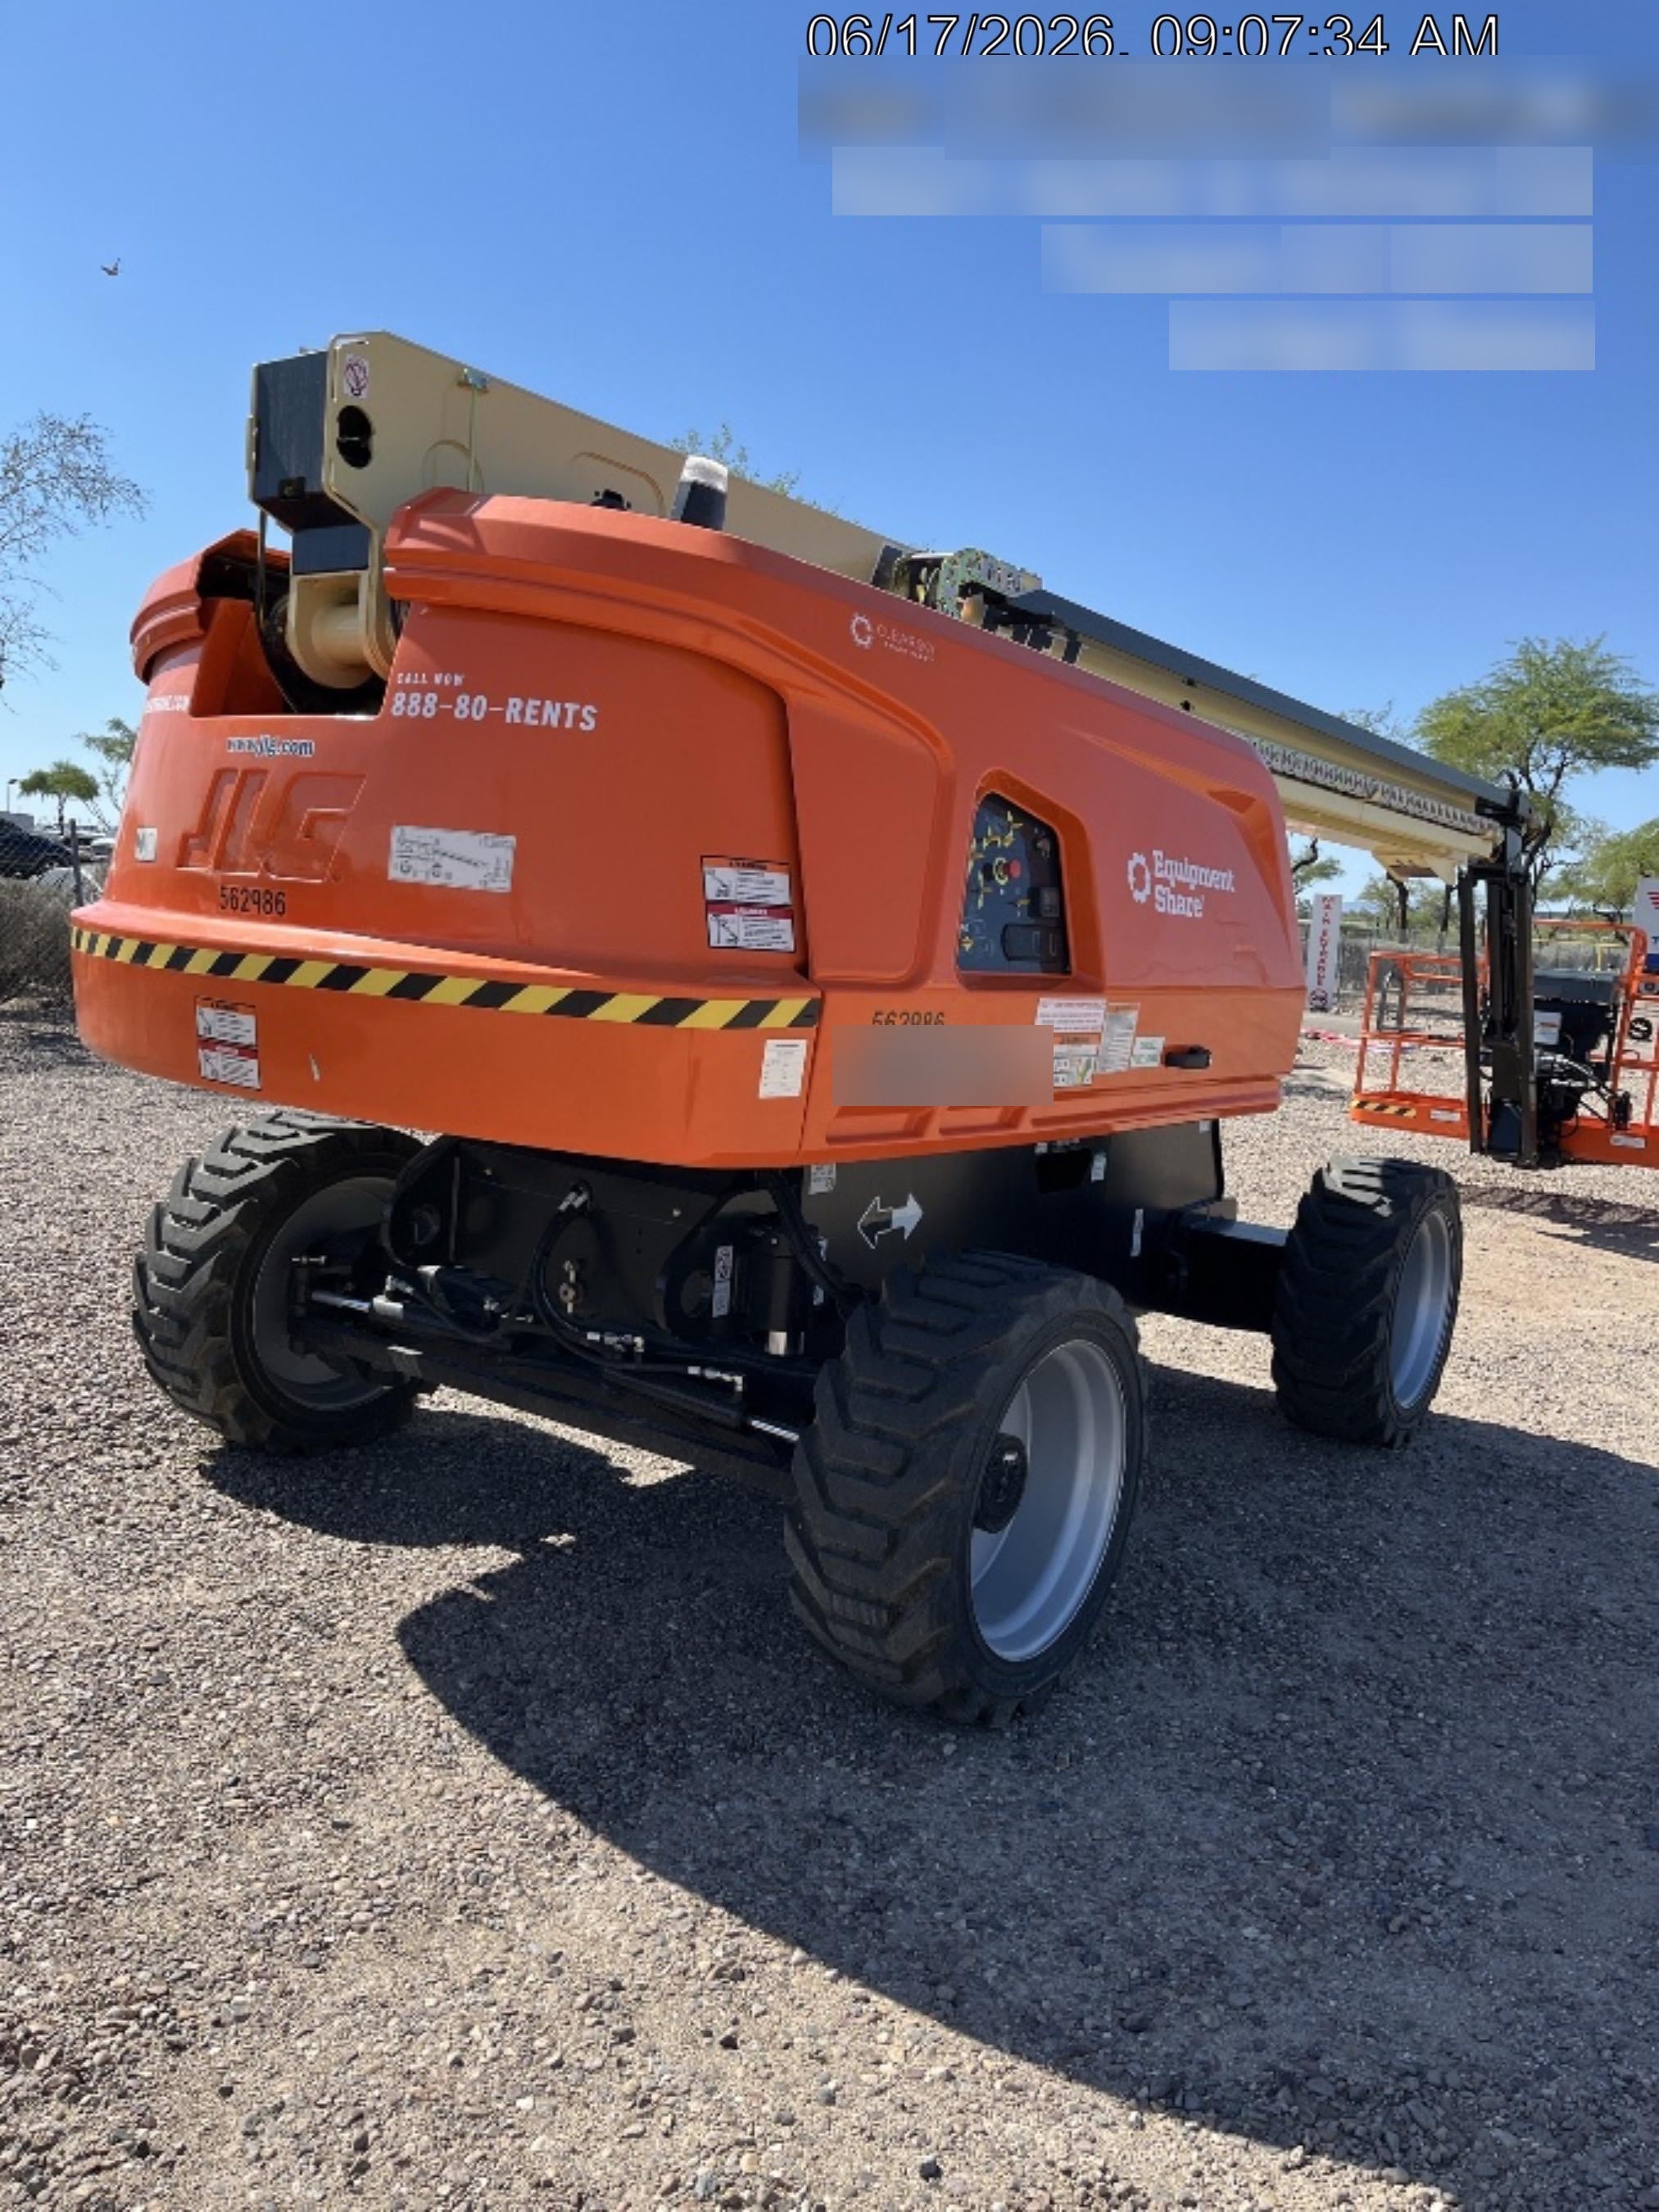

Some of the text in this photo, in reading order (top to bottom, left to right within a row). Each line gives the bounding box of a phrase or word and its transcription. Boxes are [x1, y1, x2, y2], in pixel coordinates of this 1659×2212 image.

[392, 691, 598, 731] 888-80-RENTS
[175, 766, 368, 884] JLG
[1153, 850, 1235, 892] Equipment
[220, 886, 286, 916] 562986
[1154, 884, 1203, 918] Share
